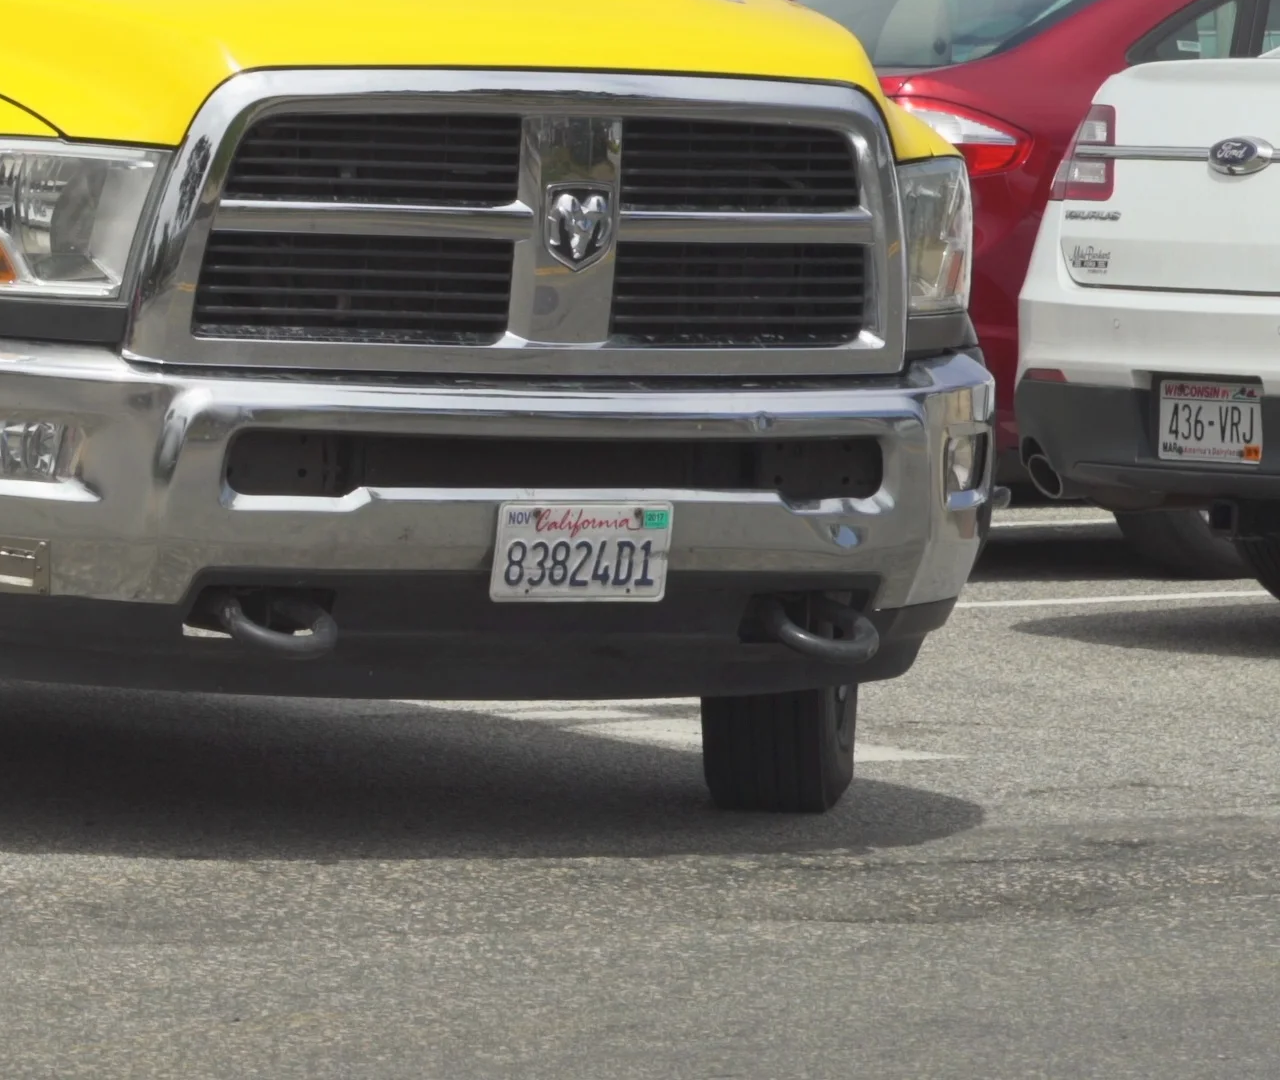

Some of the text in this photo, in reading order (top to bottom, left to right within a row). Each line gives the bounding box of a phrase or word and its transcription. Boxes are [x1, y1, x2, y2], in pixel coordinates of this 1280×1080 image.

[1217, 142, 1247, 158] Ford
[1065, 210, 1121, 221] TAURUS
[1169, 403, 1254, 443] 436-VRJ
[1163, 442, 1178, 452] MAR
[508, 508, 664, 538] NOV California 2017
[504, 540, 653, 586] 83824D1
